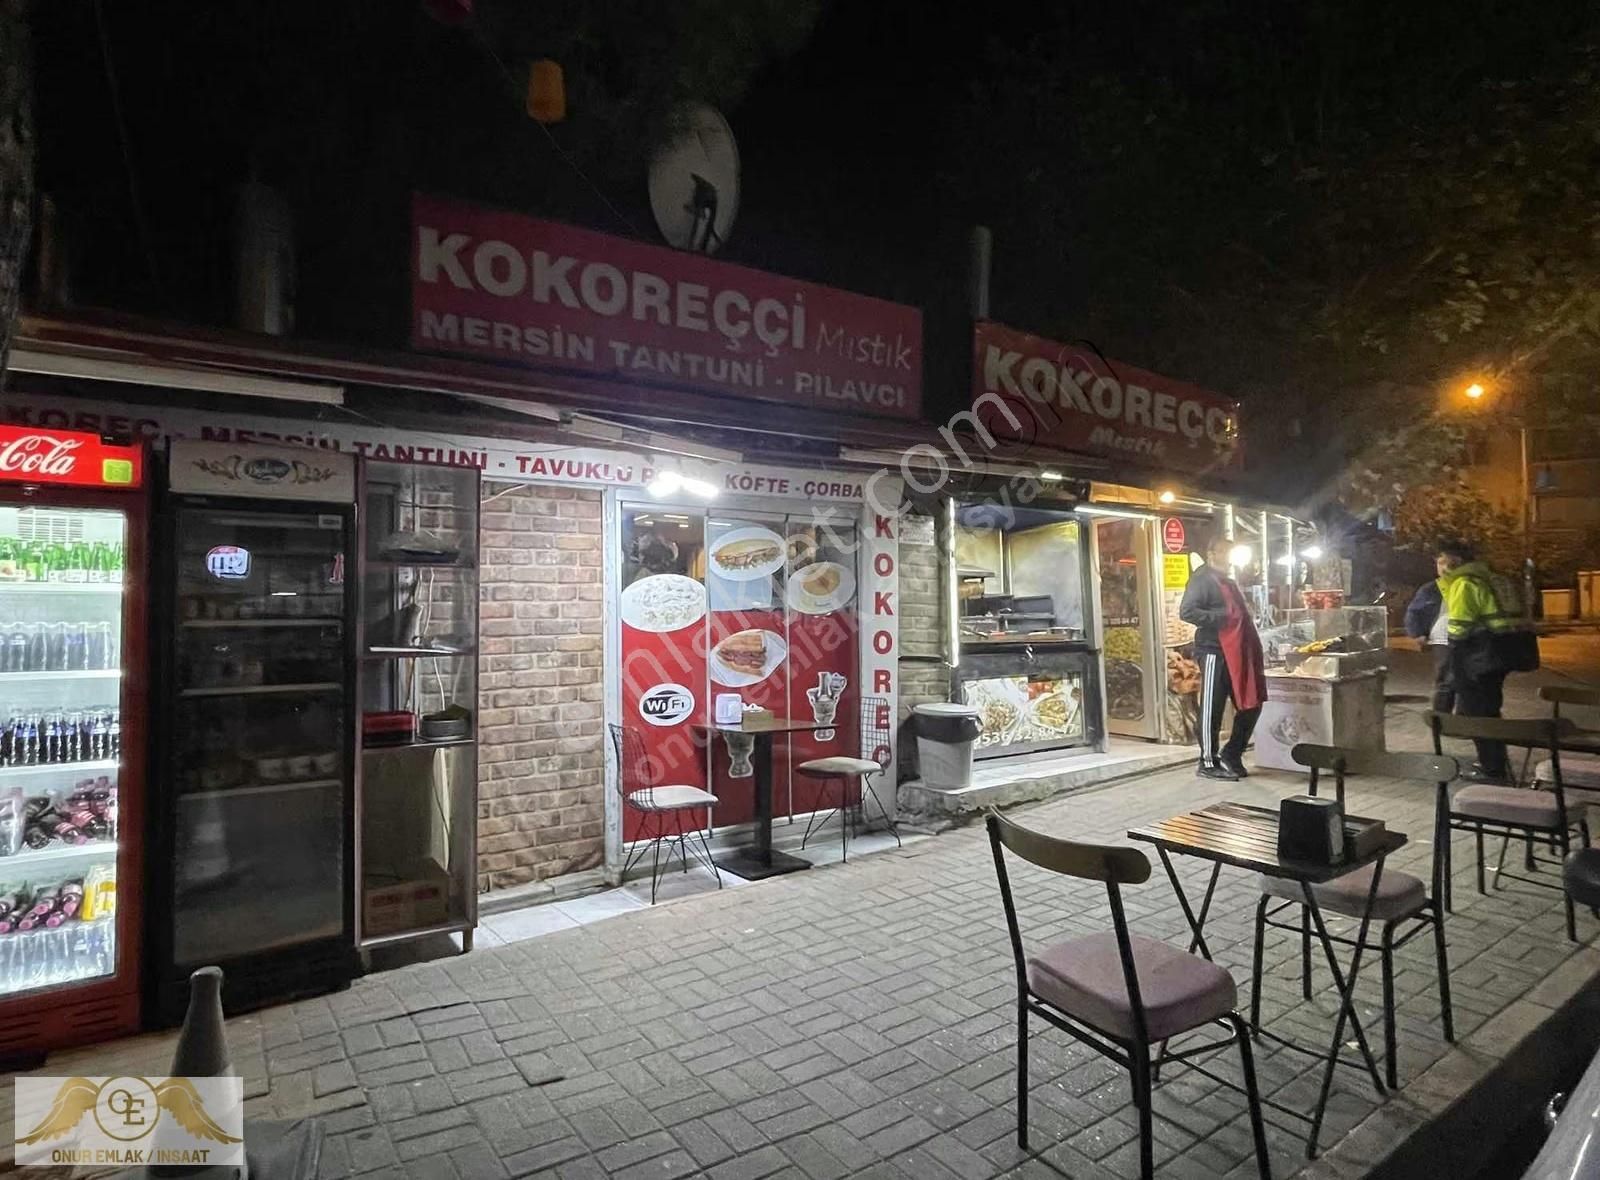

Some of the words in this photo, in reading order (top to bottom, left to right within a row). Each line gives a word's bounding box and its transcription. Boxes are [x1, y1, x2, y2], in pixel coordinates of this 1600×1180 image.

[418, 226, 806, 358] KOKOREÇÇİ
[420, 310, 595, 362] MERSİN
[609, 341, 765, 387] TANTUNİ
[725, 470, 789, 495] KÖFTE
[804, 480, 865, 501] ÇORBA
